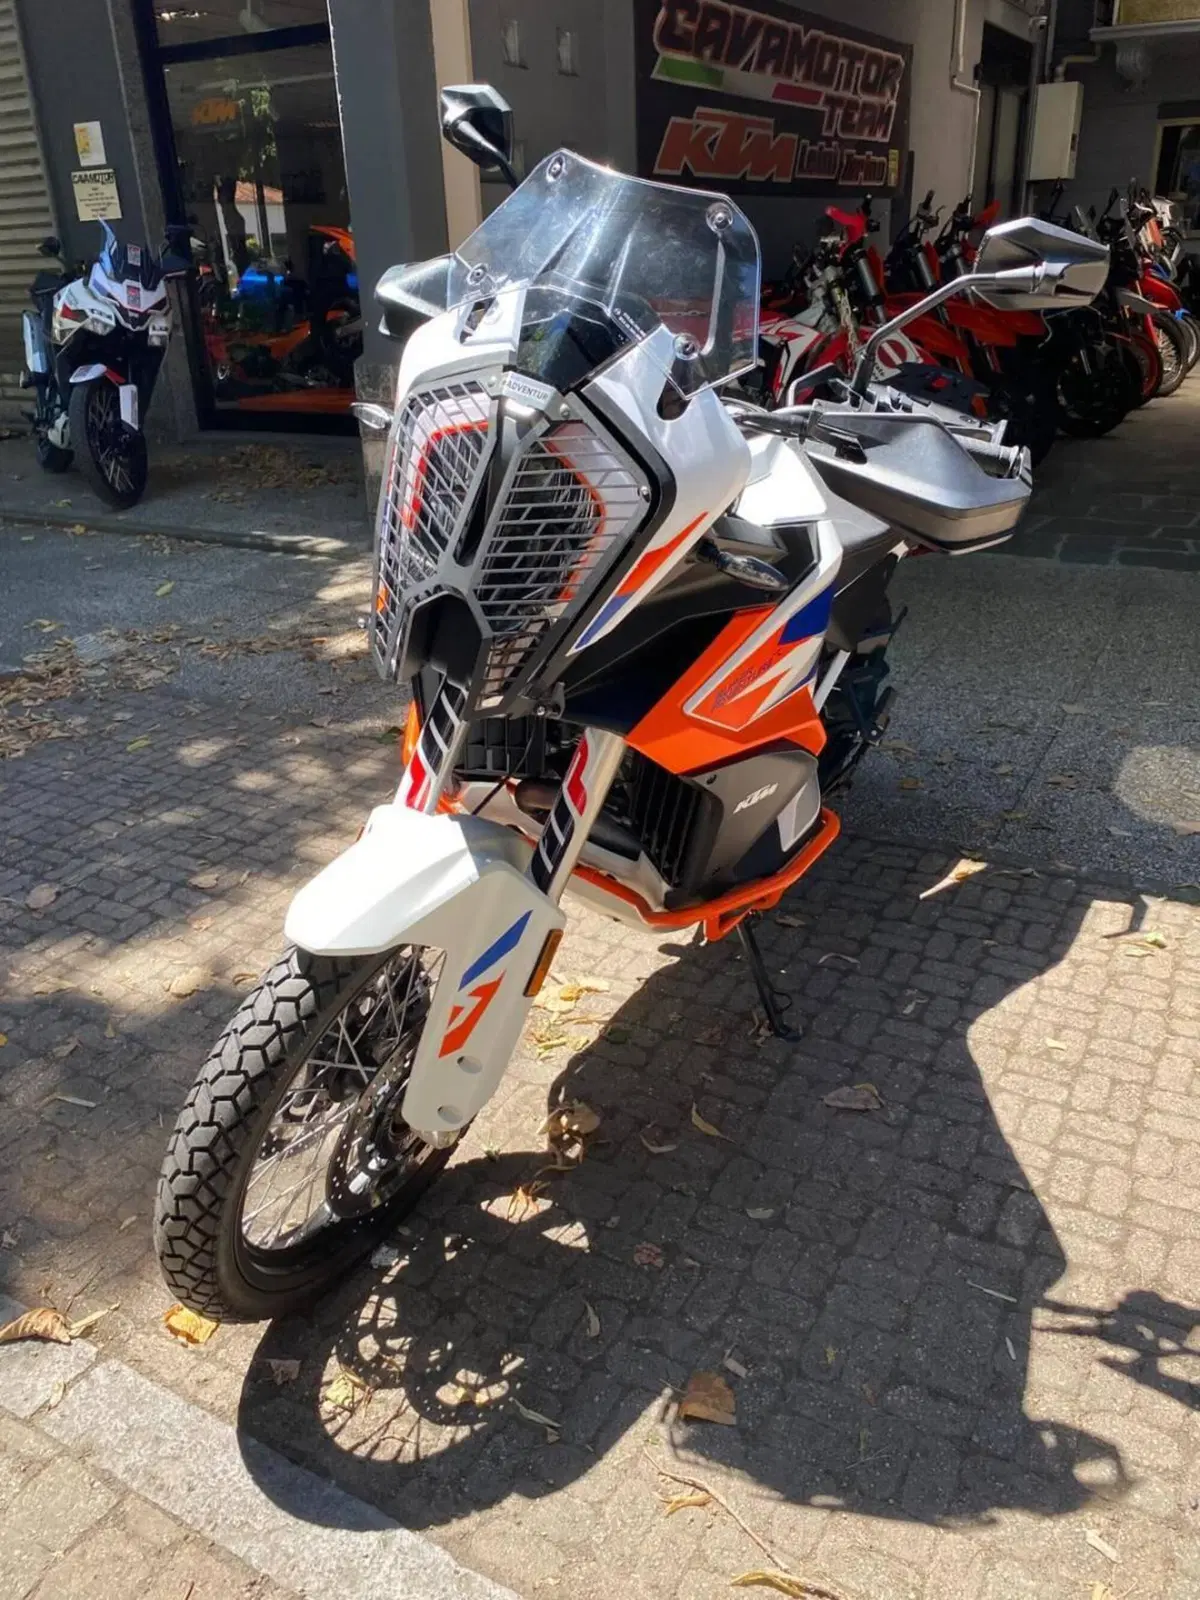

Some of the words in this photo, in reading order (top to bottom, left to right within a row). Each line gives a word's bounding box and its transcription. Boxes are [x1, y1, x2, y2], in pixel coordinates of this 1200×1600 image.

[653, 0, 905, 104] CAVAMOTOR
[653, 106, 799, 182] KTM
[821, 97, 897, 143] TEAM
[732, 782, 779, 815] KTM
